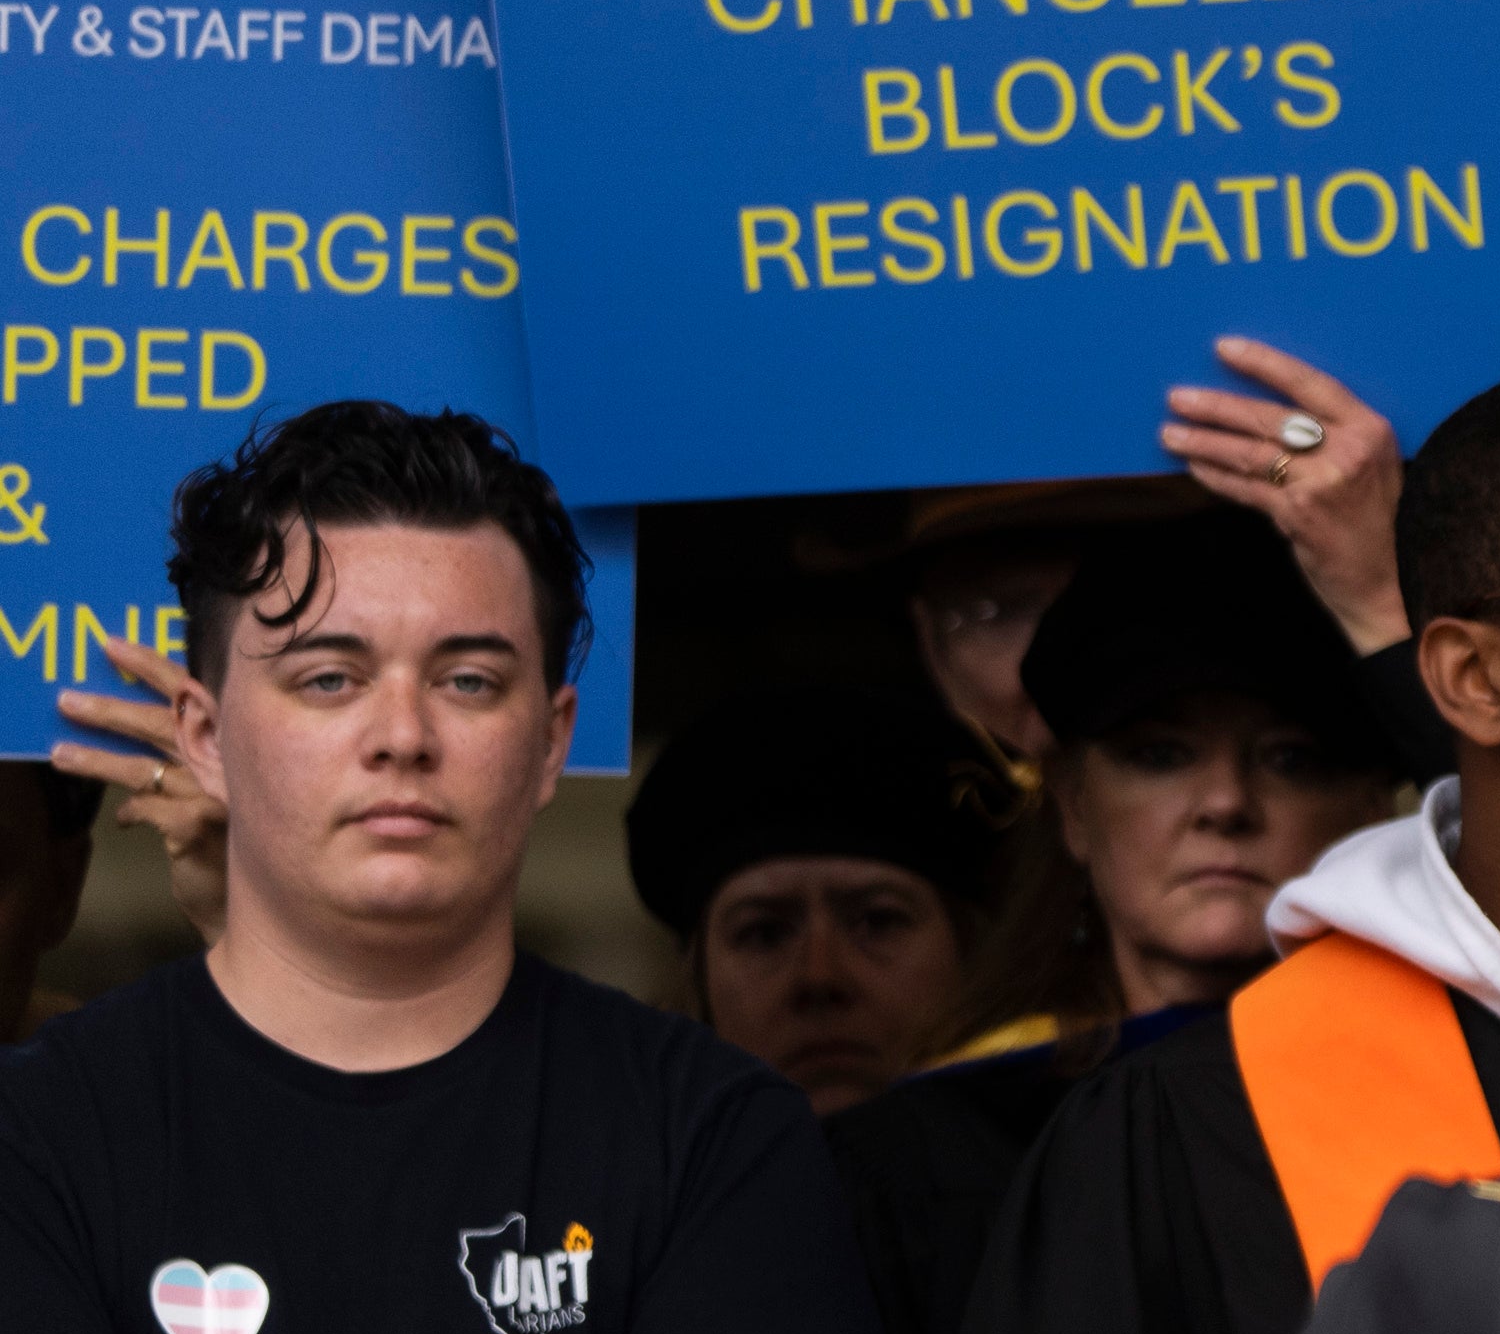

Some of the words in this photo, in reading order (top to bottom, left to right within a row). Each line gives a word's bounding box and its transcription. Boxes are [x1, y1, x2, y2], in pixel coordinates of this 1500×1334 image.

[71, 4, 115, 58] &
[128, 6, 307, 62] STAFF
[320, 12, 497, 68] DEMA
[863, 42, 1341, 154] BLOCK'S
[20, 205, 519, 298] CHARGES
[739, 165, 1484, 292] RESIGNATION
[2, 325, 267, 410] PPED
[0, 464, 49, 544] &
